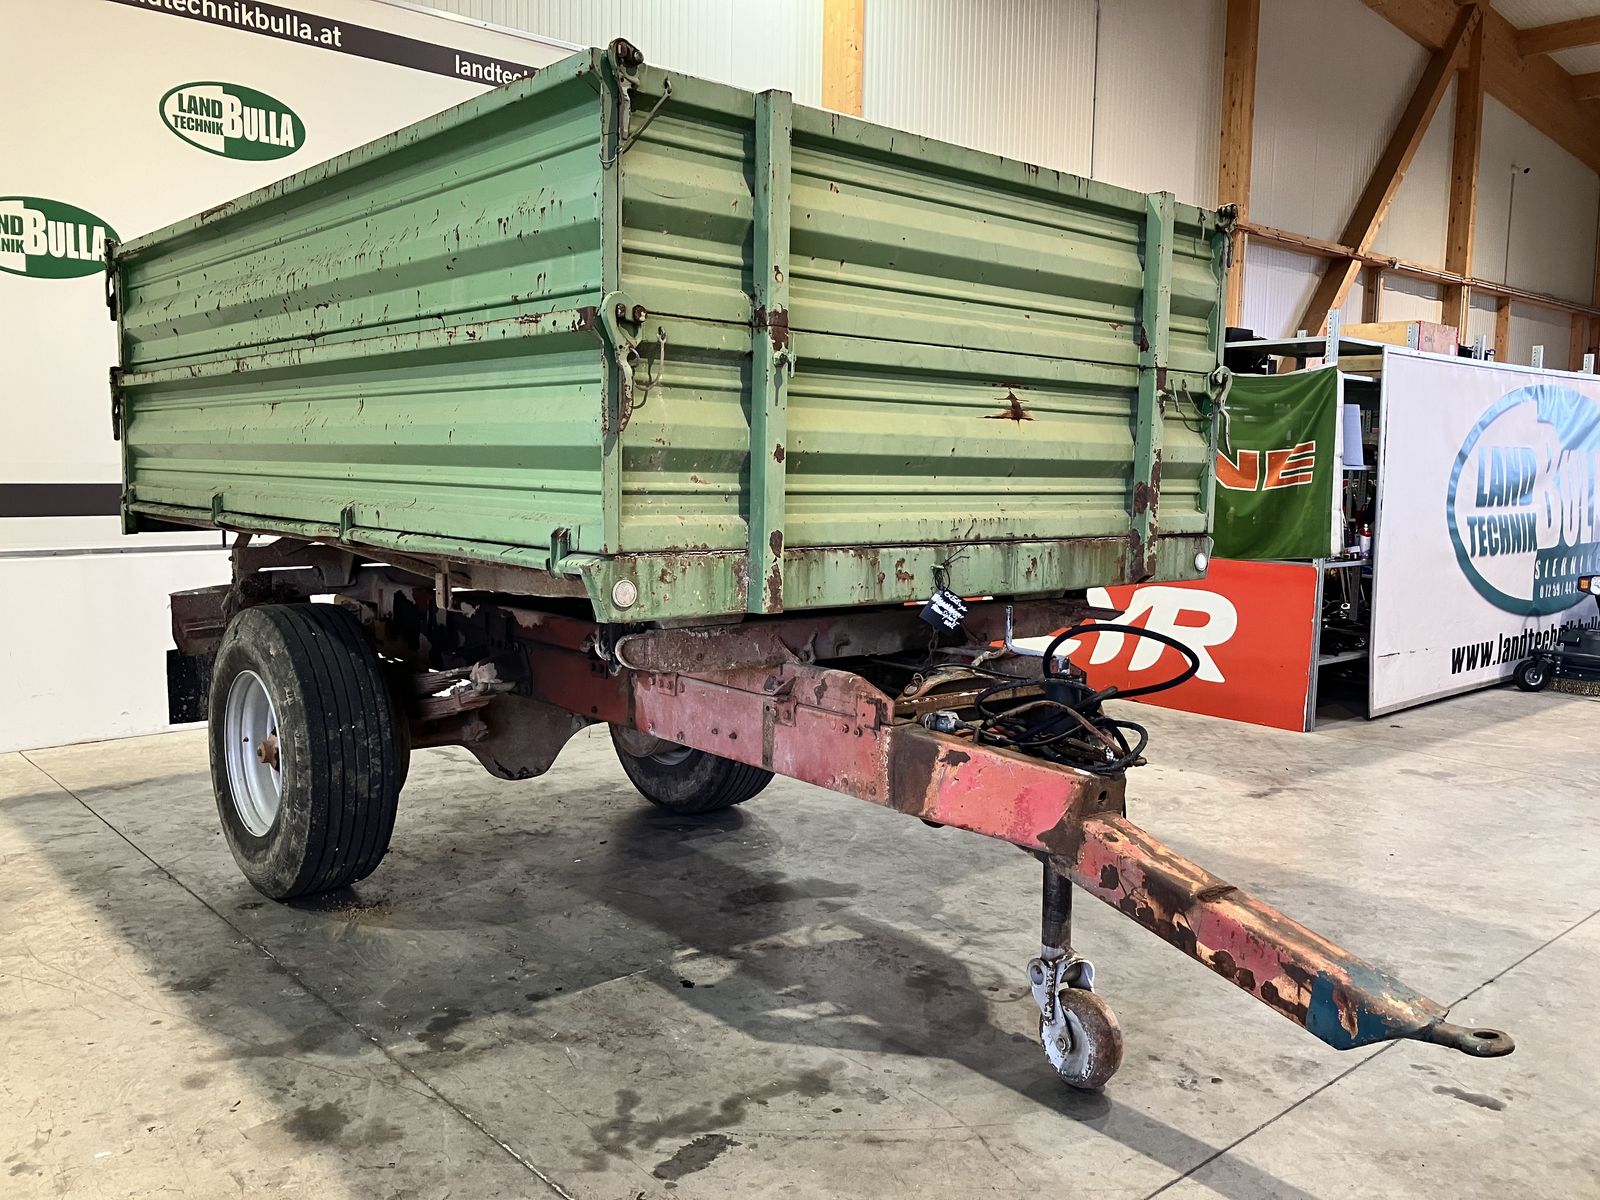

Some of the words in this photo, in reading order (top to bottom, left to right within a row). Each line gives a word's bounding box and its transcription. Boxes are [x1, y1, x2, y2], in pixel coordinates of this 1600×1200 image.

[172, 114, 224, 136] TECHNIK
[177, 92, 223, 119] LAND
[223, 93, 296, 148] BULLA
[24, 208, 107, 262] BULLA
[1475, 447, 1537, 508] LAND
[1466, 512, 1538, 558] TECHNIK
